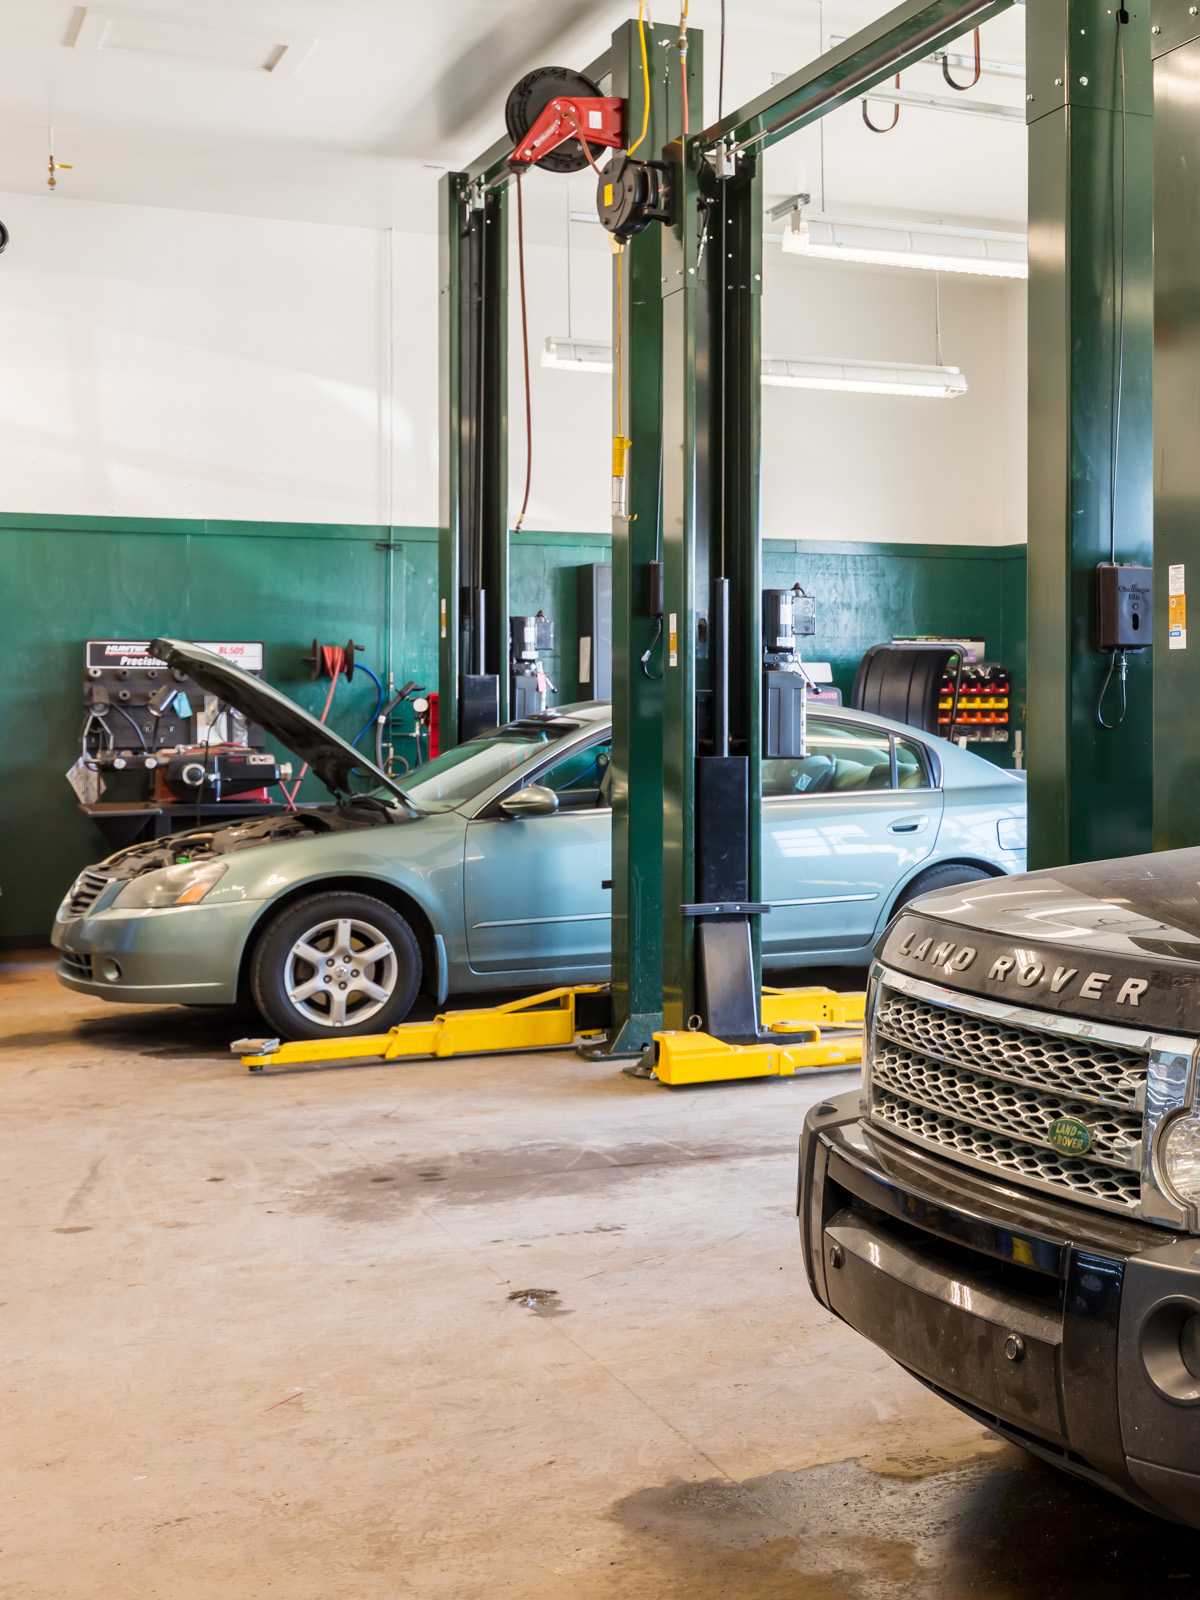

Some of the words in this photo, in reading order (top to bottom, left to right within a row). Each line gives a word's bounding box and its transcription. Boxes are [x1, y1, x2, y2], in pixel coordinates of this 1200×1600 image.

[104, 645, 151, 653] HUNTE
[898, 932, 978, 971] LAND
[988, 955, 1149, 1006] ROVER
[1056, 1134, 1084, 1150] ROVER
